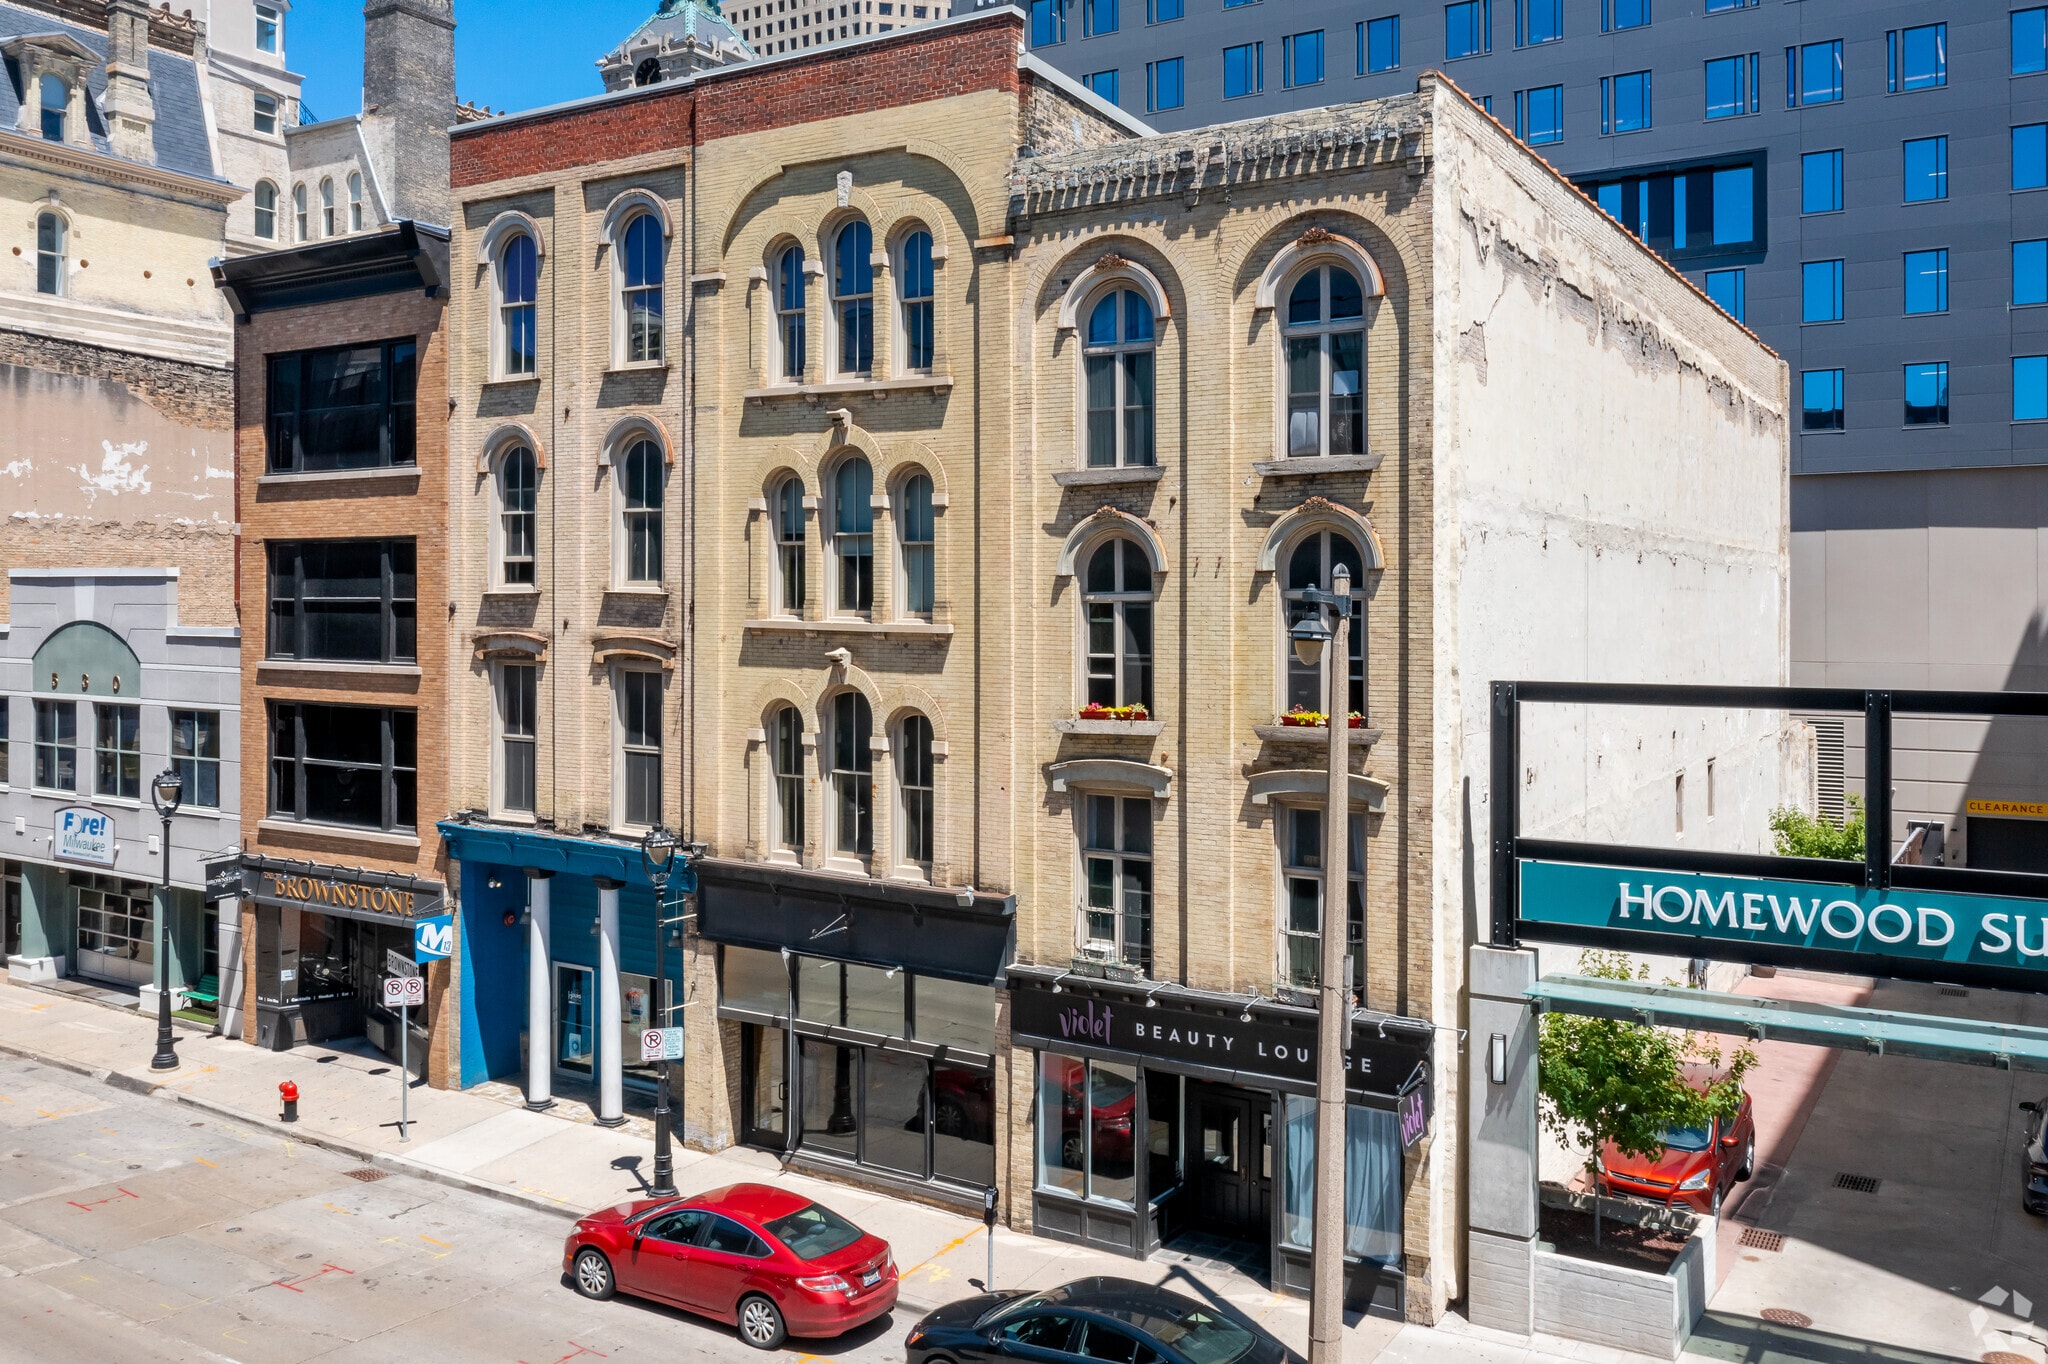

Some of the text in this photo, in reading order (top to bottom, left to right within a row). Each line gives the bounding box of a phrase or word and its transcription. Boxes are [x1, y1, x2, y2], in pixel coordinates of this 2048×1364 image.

[63, 812, 106, 836] Fore!
[1969, 802, 2044, 814] CLEARANCE
[63, 834, 106, 852] Milwaukee
[275, 876, 415, 917] BROWNSTONE
[1618, 882, 2048, 957] HOMEWOOD SU
[443, 941, 452, 952] 13
[1059, 999, 1372, 1073] violet BEAUTY LOUGE
[1402, 1093, 1424, 1146] violet
